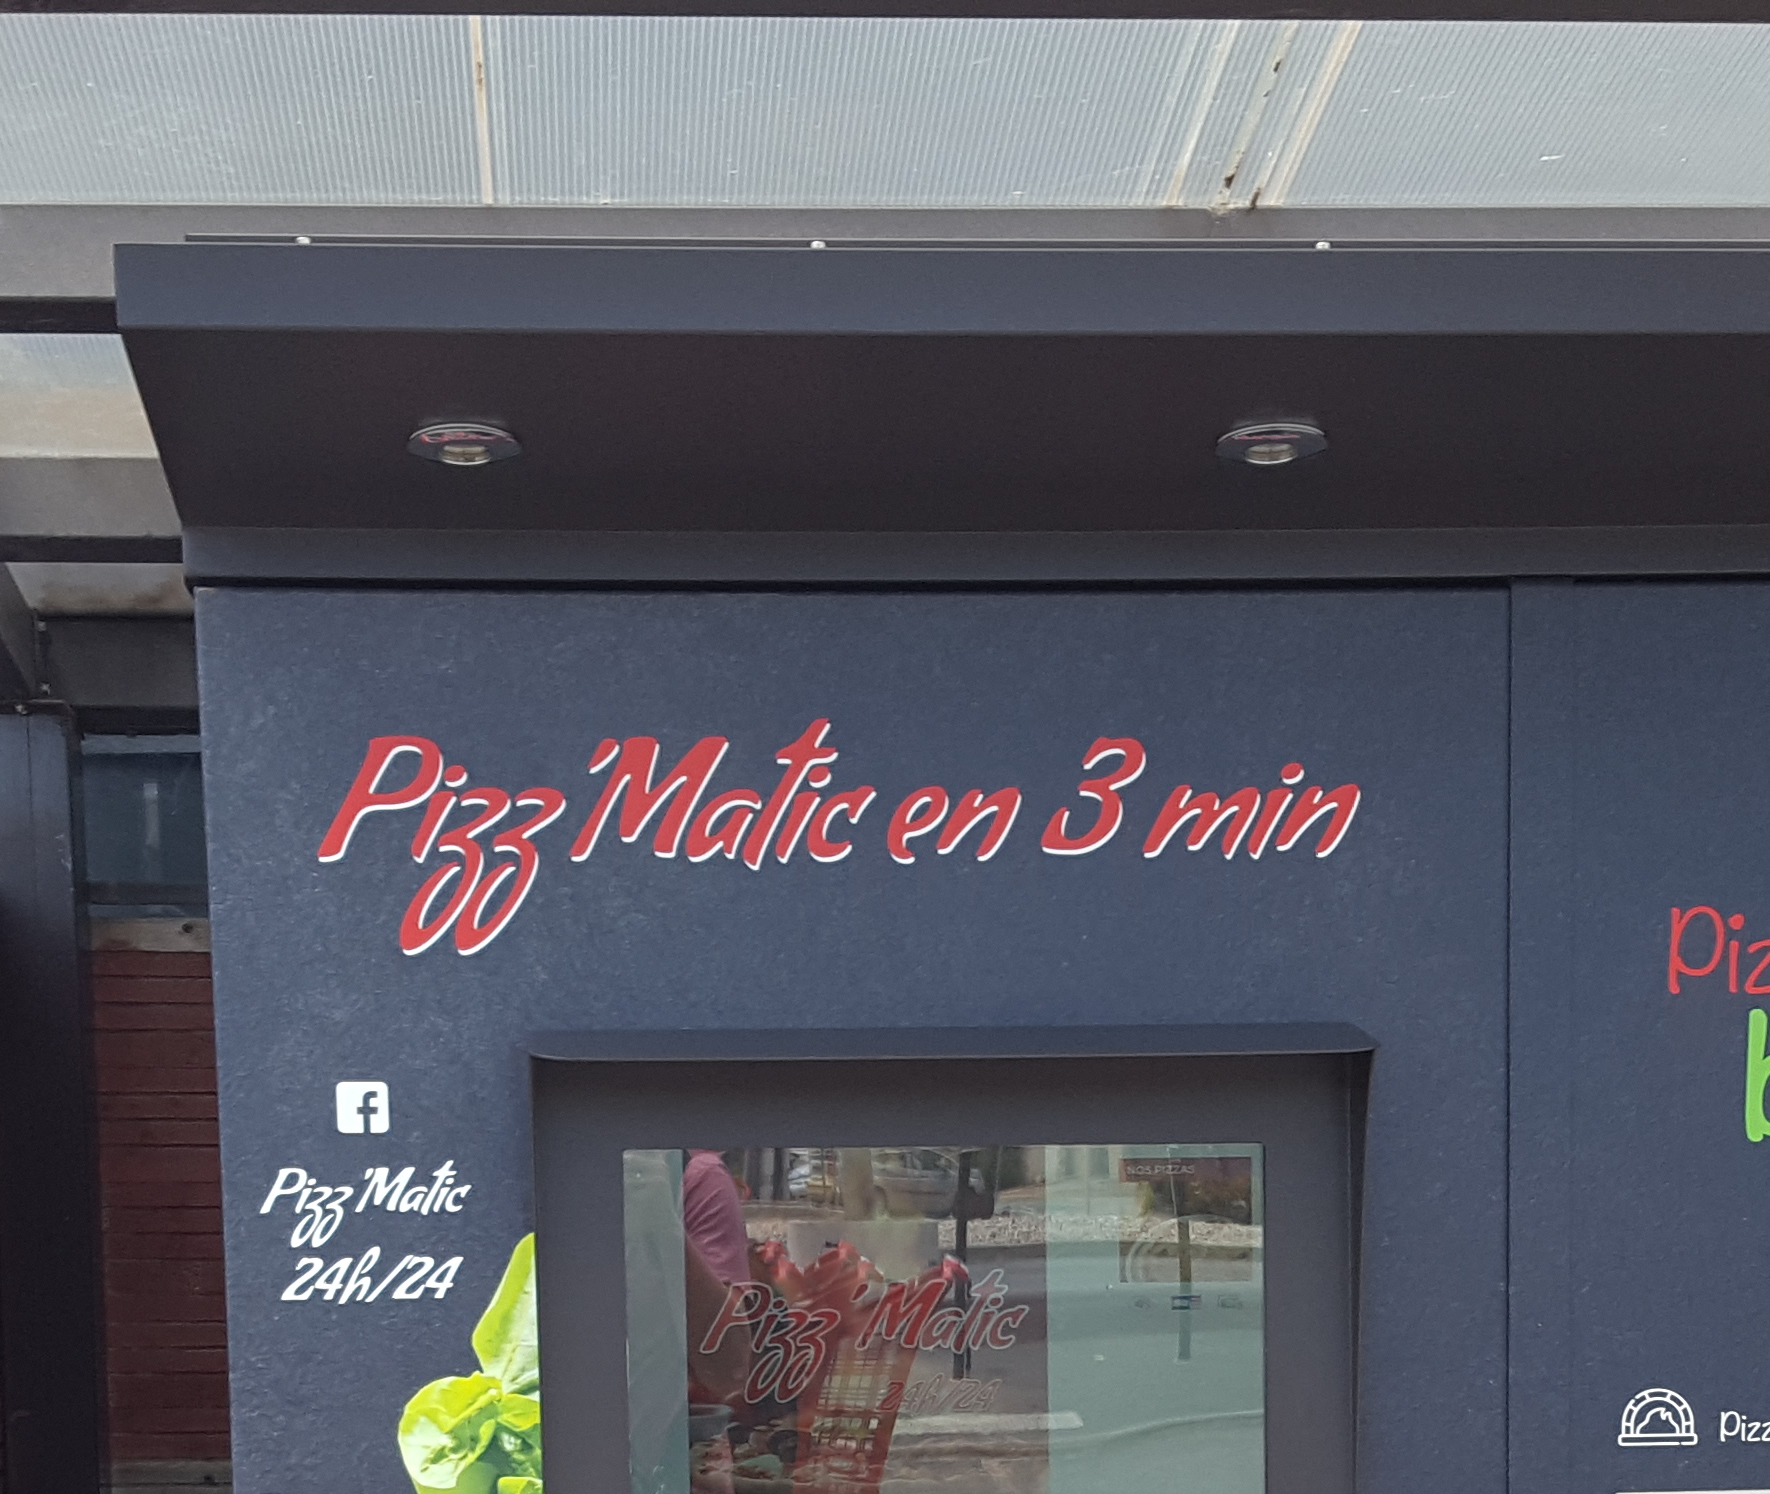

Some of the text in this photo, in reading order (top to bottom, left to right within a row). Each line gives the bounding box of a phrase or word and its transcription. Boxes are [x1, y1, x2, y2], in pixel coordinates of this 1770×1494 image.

[886, 785, 1022, 865] en
[1040, 736, 1148, 859] 3
[1140, 760, 1361, 861] min
[280, 1246, 464, 1305] 24h/24
